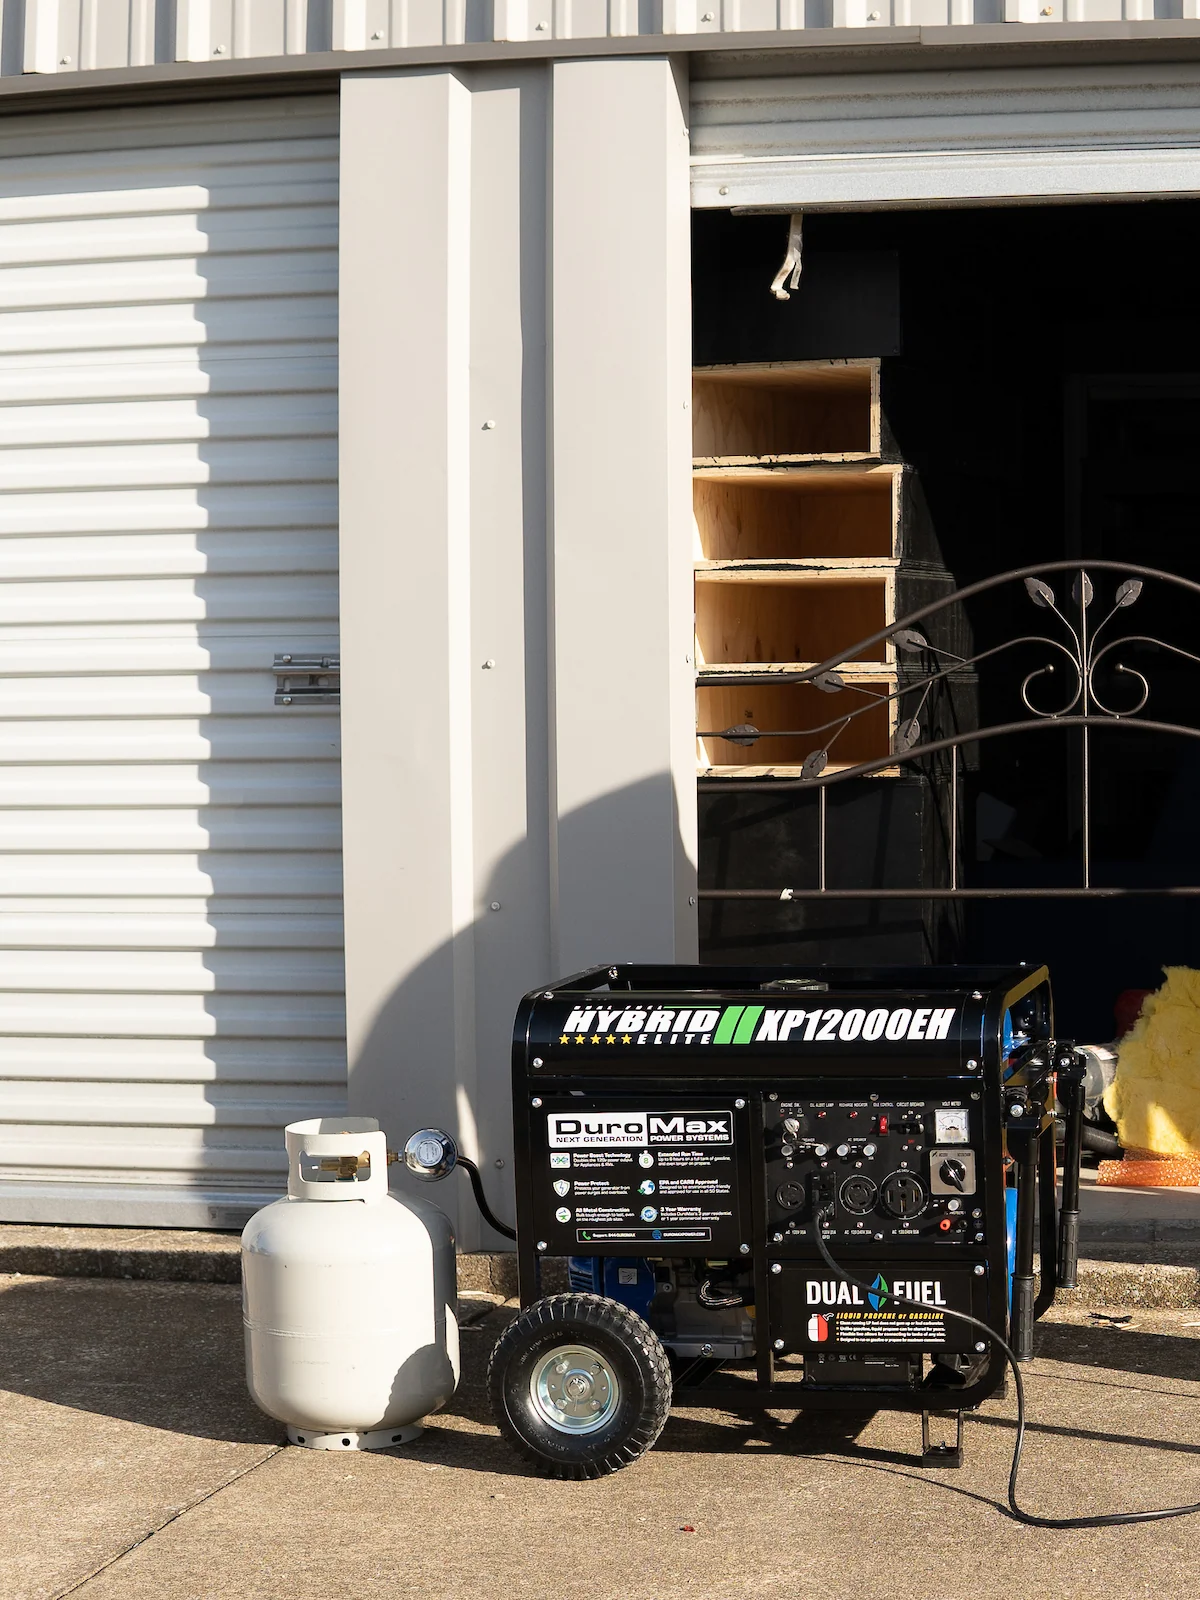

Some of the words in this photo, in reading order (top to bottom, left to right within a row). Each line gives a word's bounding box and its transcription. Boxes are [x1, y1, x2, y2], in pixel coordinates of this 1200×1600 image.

[563, 1010, 720, 1032] HYBRID
[755, 1008, 956, 1042] XP12000EH
[637, 1034, 712, 1044] ELITE
[806, 1281, 864, 1305] DUAL
[893, 1281, 946, 1305] FUEL
